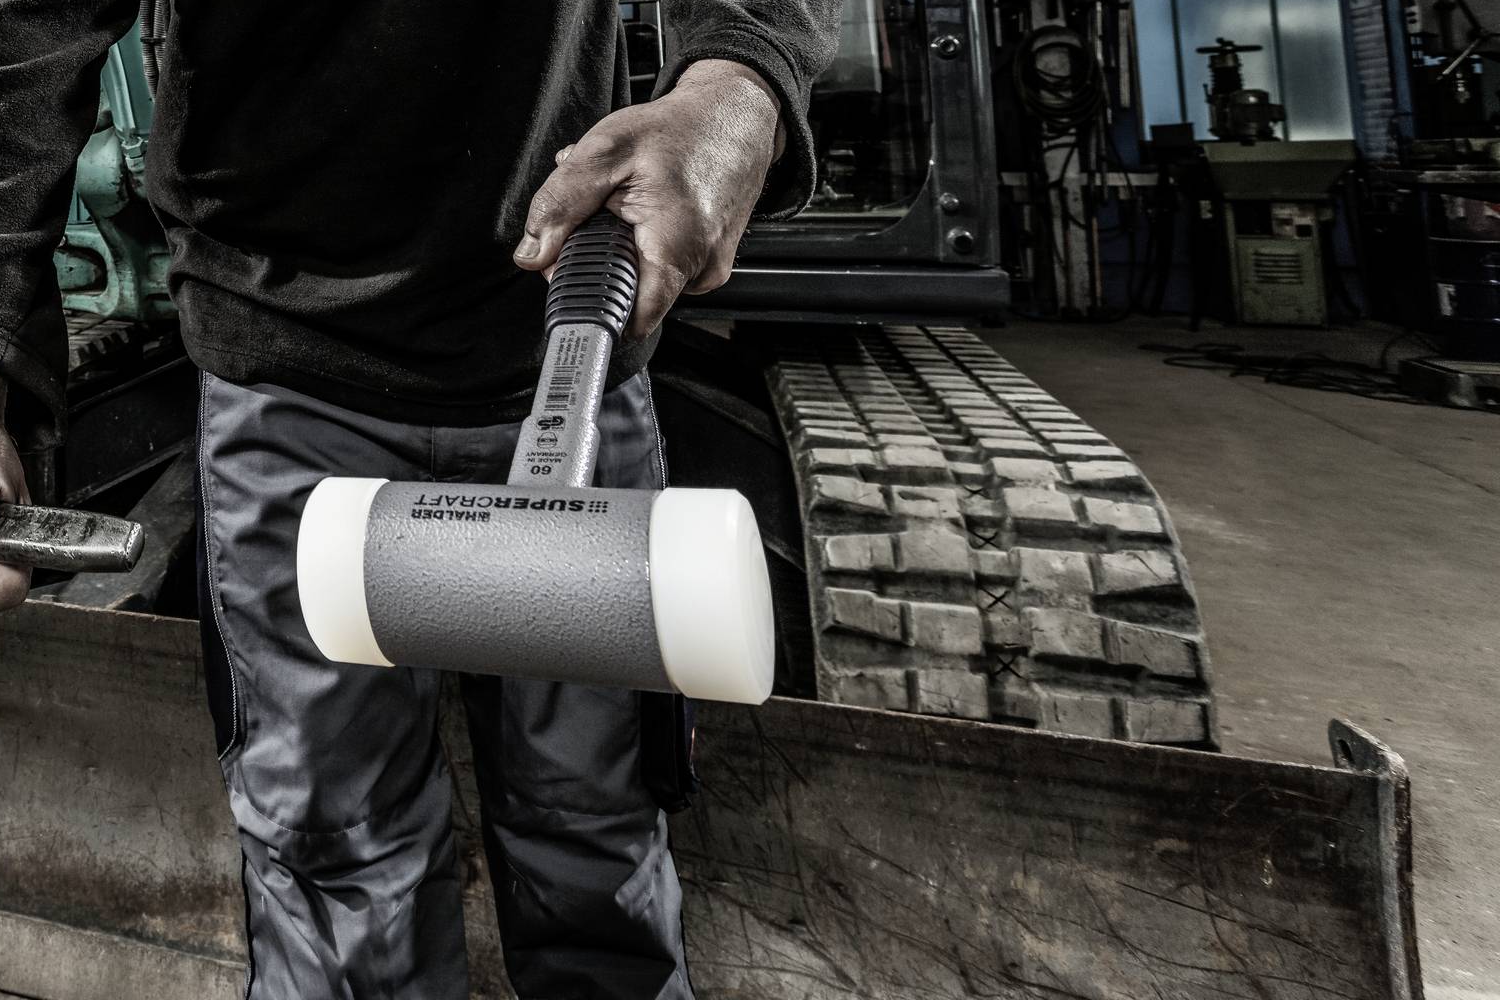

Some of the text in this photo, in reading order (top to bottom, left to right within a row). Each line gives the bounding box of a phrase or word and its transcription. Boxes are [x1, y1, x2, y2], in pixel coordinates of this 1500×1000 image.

[530, 465, 552, 475] 60
[414, 494, 586, 512] SUPERCRAFT
[411, 508, 479, 521] HALDER
